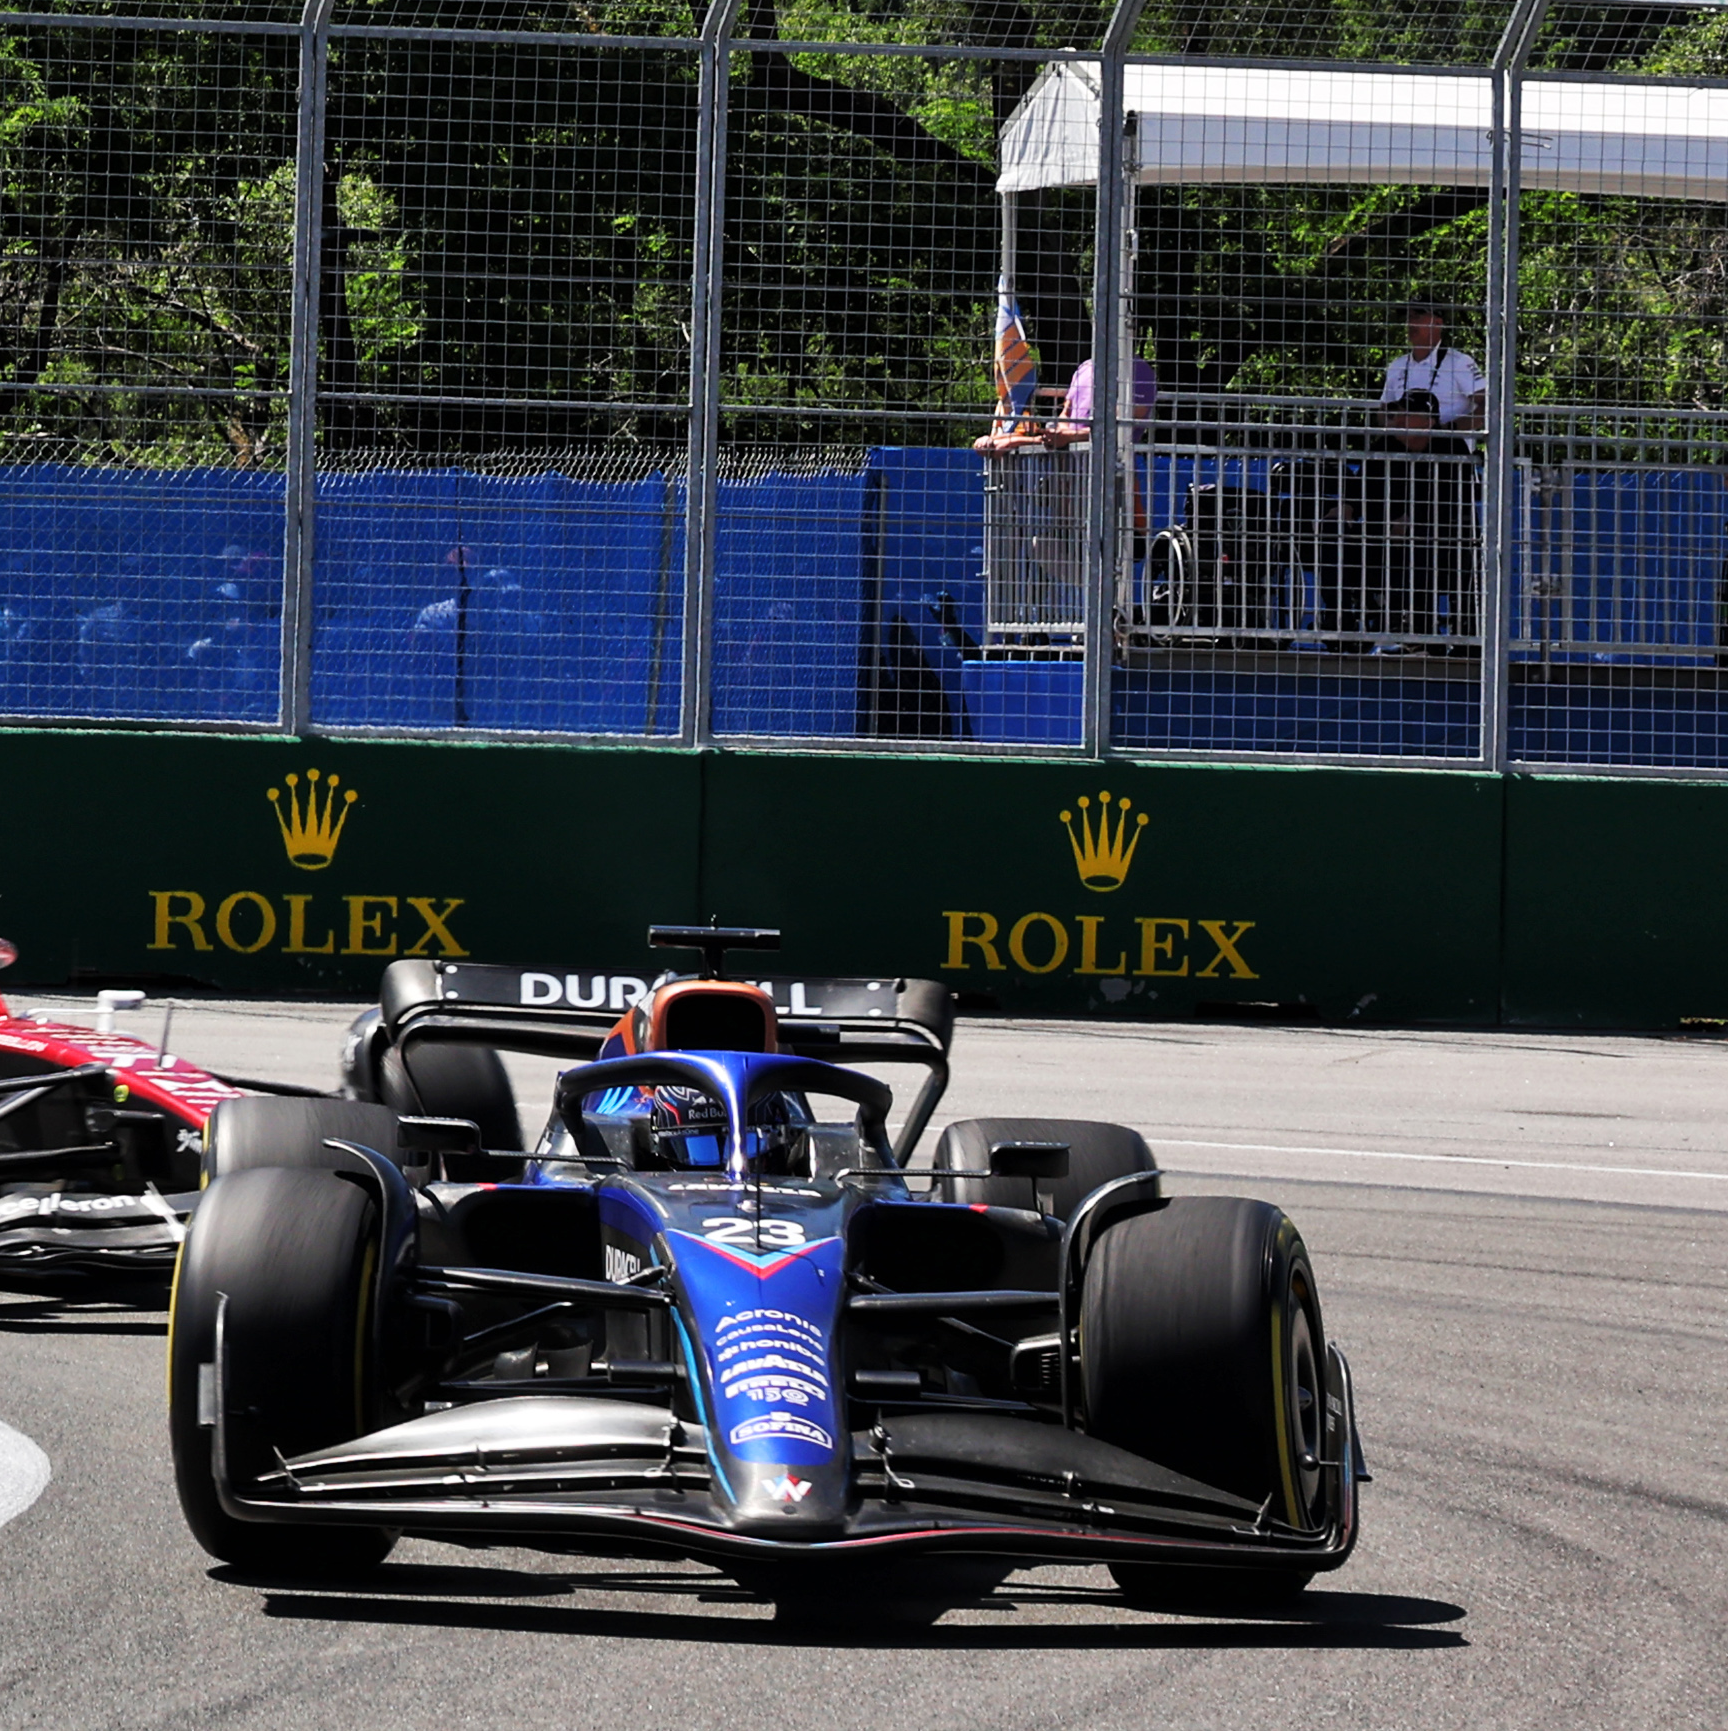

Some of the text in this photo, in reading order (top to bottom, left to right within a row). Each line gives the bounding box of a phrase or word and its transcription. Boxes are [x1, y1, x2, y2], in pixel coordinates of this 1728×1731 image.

[148, 891, 469, 957] ROLEX
[941, 910, 1259, 979] ROLEX
[520, 972, 822, 1015] DURLL
[688, 1107, 708, 1120] Red
[702, 1217, 806, 1246] 23
[715, 1309, 823, 1338] Acronis
[738, 1421, 826, 1443] SOFINA
